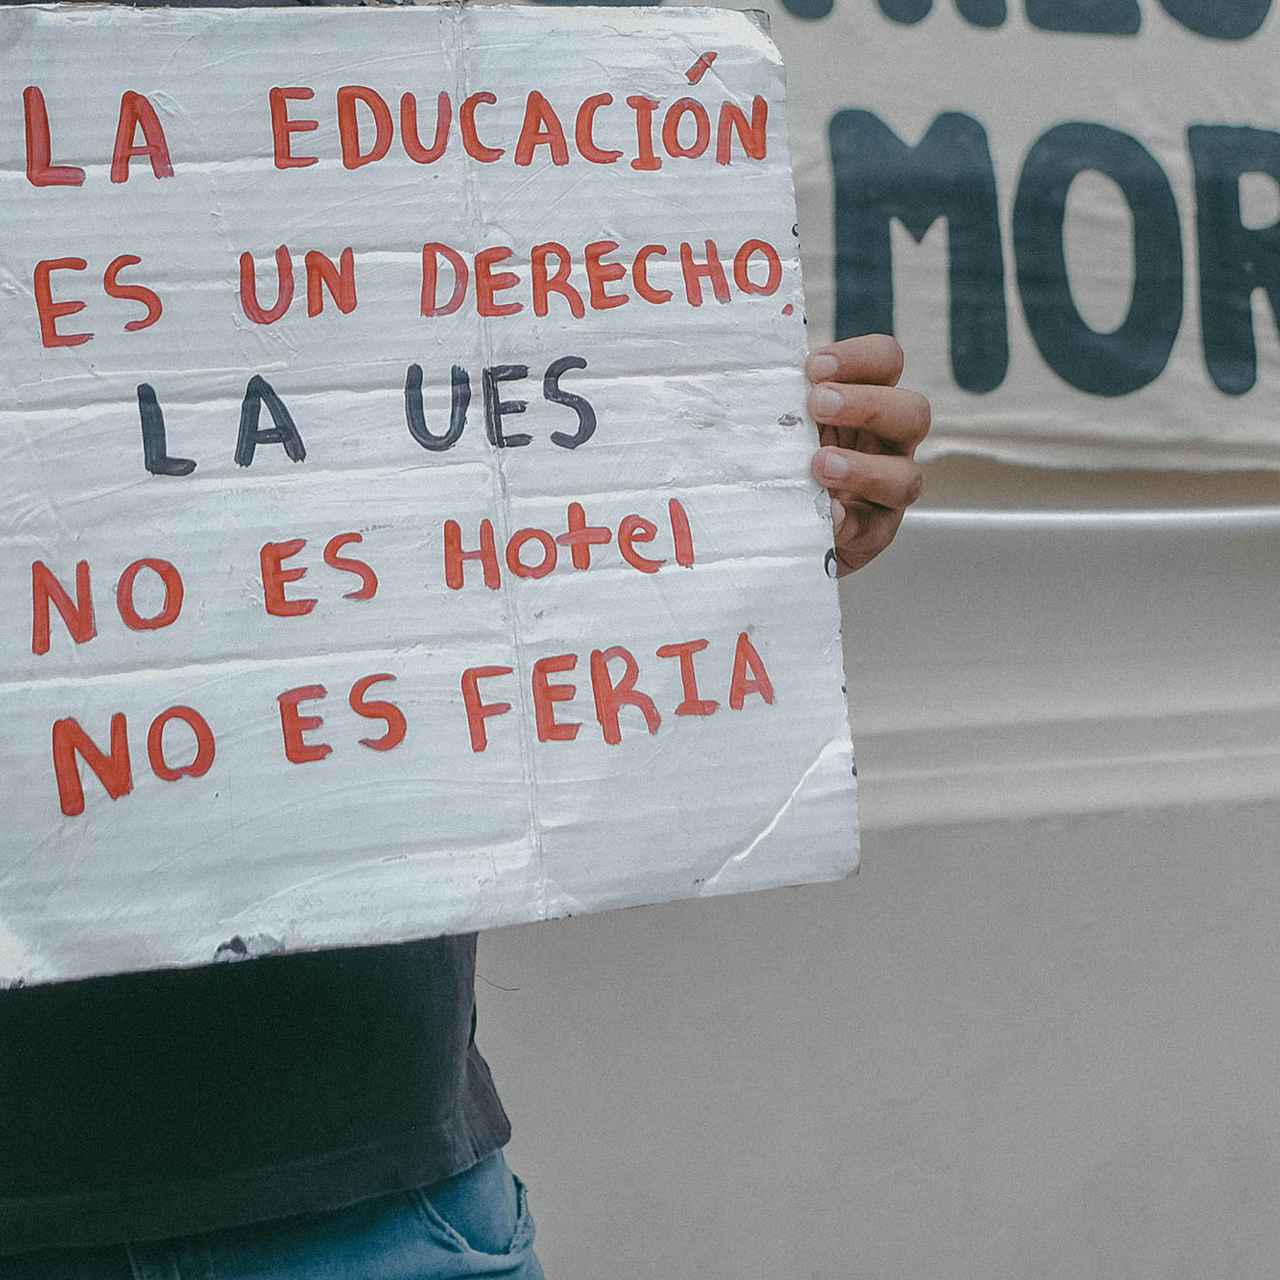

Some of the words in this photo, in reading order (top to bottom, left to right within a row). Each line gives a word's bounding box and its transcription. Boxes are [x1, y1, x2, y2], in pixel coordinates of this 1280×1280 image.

[22, 86, 175, 187] LA
[269, 51, 769, 171] EDUCACIÓN
[33, 255, 164, 349] ES
[238, 246, 358, 326] UN
[137, 373, 307, 477] LA
[405, 356, 597, 451] UES
[30, 558, 185, 656] NO
[259, 532, 379, 619] ES
[442, 498, 695, 591] Hotel
[51, 705, 216, 817] NO
[277, 672, 408, 765] ES
[460, 631, 774, 754] FERIA
